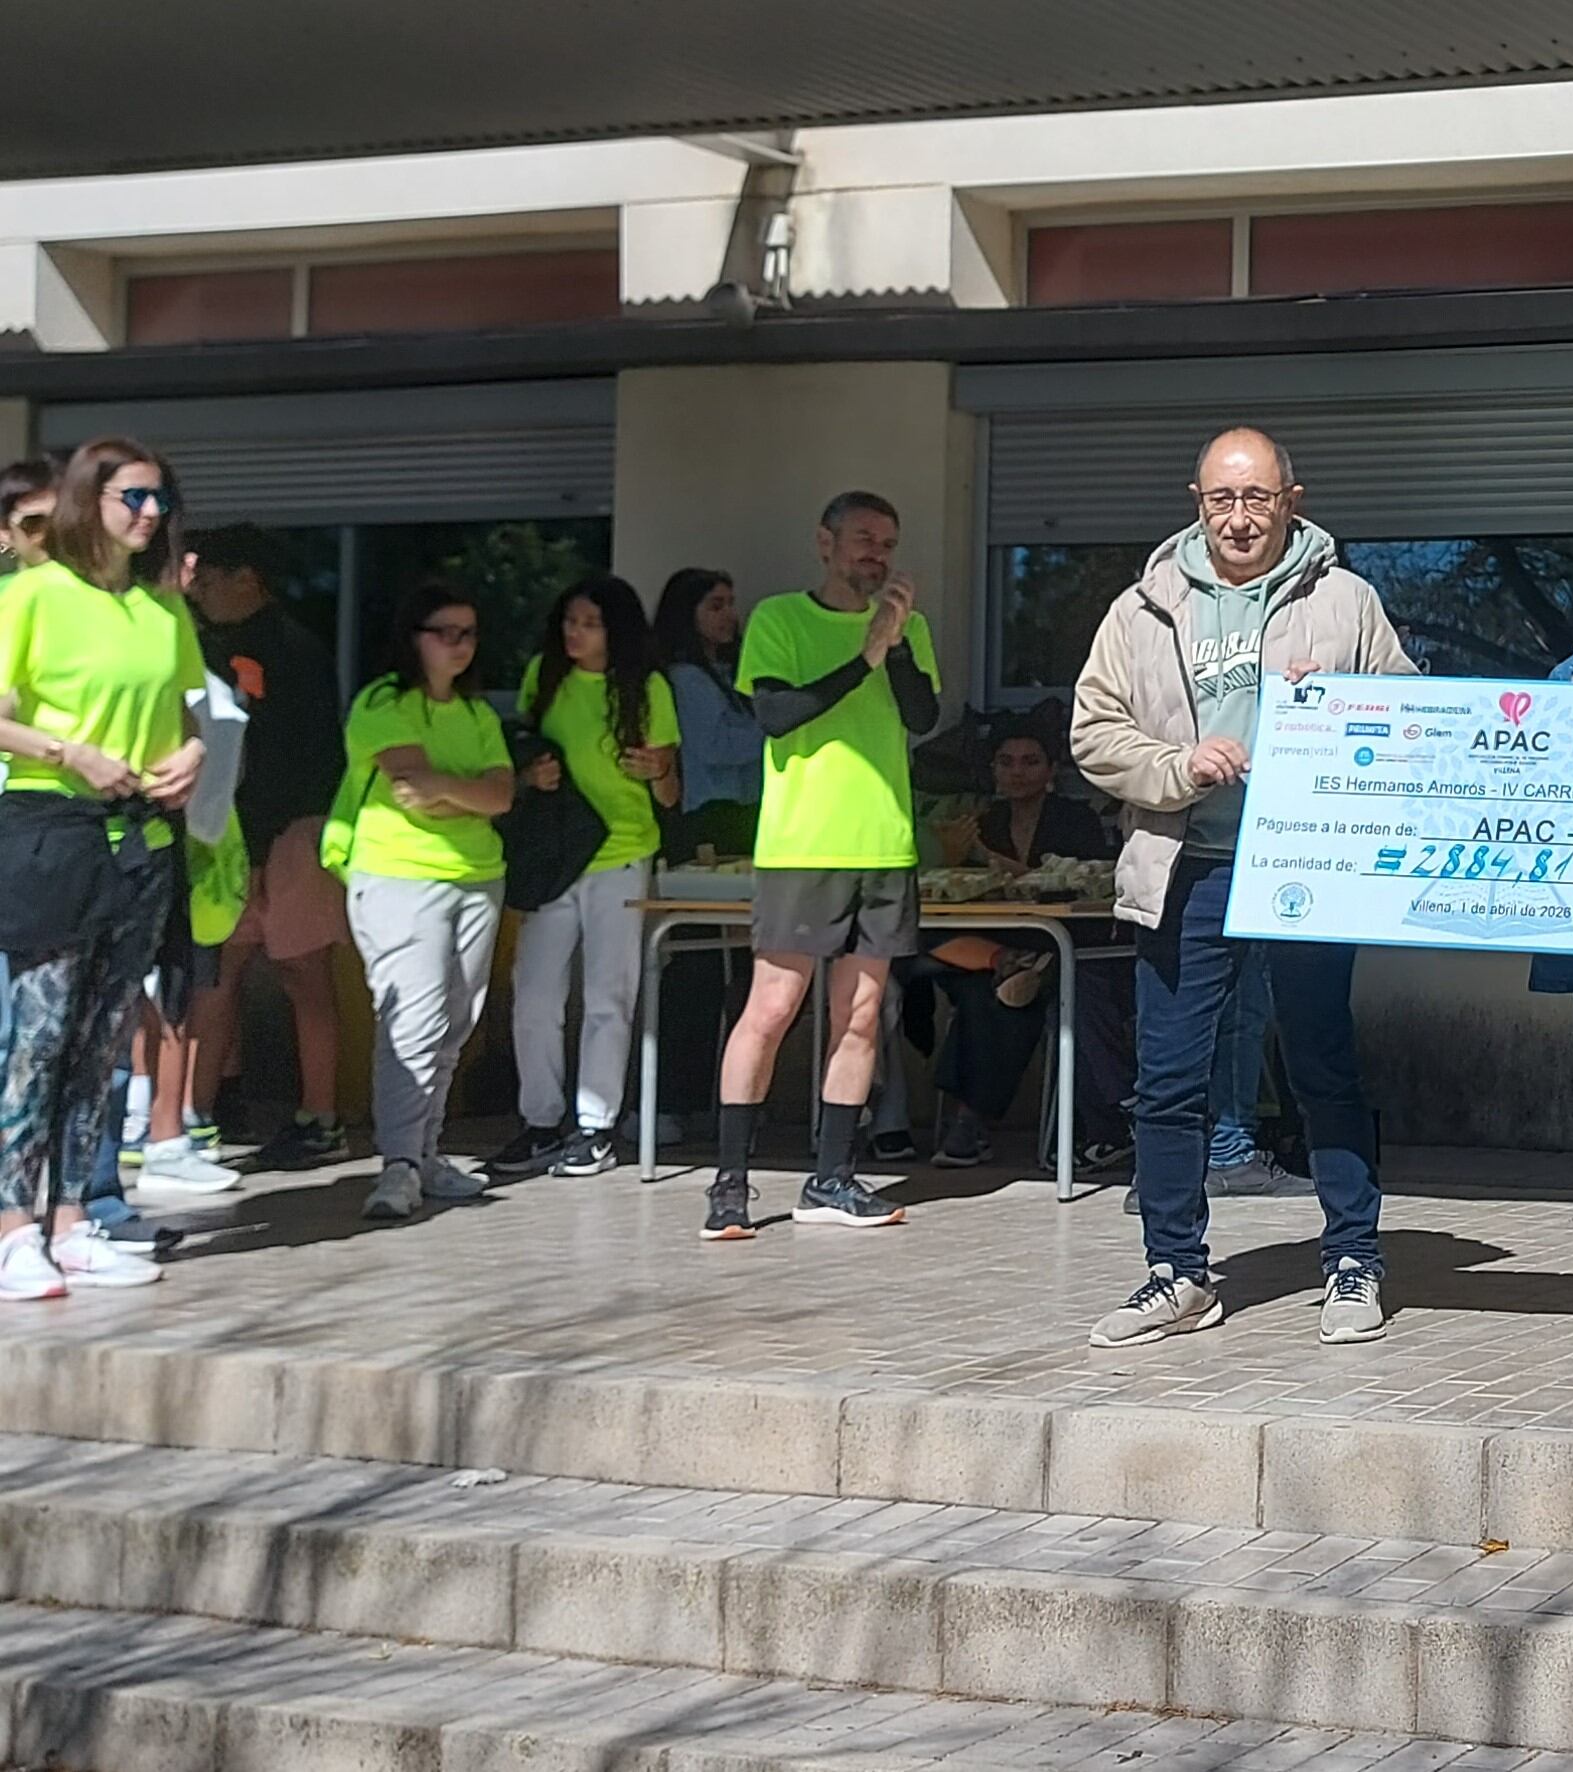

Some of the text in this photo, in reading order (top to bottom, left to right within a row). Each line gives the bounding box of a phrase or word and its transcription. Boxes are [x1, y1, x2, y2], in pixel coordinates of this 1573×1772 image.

[1470, 729, 1551, 752] APAC
[1314, 775, 1341, 790] IES
[1346, 776, 1424, 793] Hermanos
[1427, 780, 1486, 796] Amorós
[1502, 783, 1519, 797] IV
[1256, 817, 1418, 837] Páguese a la orden de:
[1473, 817, 1555, 843] APAC
[1251, 854, 1358, 873] La cantidad de:
[1411, 900, 1455, 916] Villena,
[1471, 903, 1486, 914] de
[1490, 904, 1517, 916] abril
[1520, 905, 1536, 917] de
